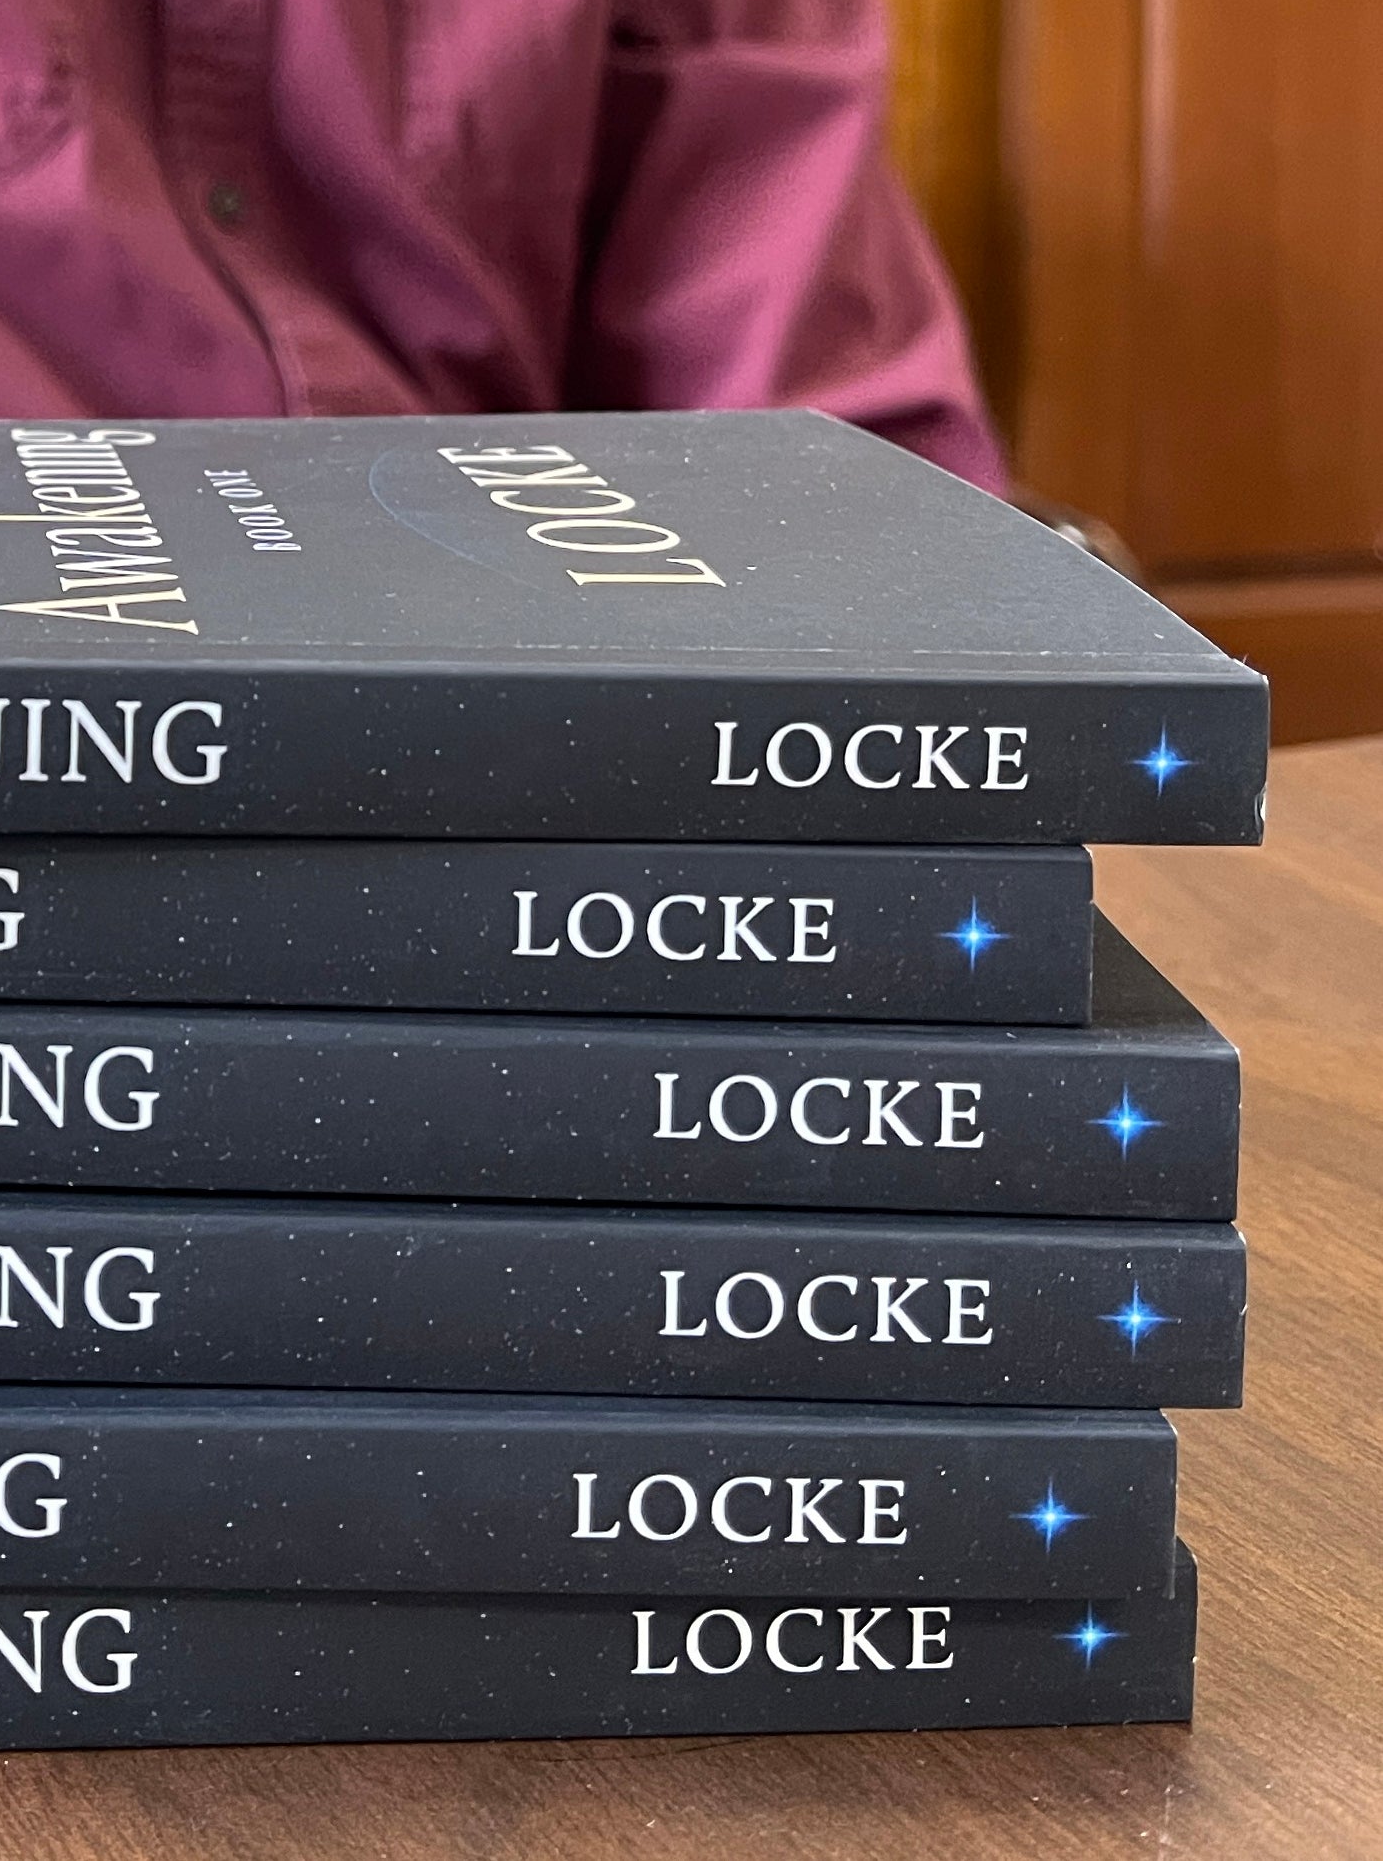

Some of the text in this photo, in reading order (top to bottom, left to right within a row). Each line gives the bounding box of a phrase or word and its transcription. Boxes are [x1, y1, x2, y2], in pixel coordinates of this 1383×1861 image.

[204, 469, 302, 551] BOOK ONE
[437, 445, 727, 588] LOCKE
[709, 720, 1030, 791] LOCKE
[510, 889, 838, 964] LOCKE
[651, 1071, 986, 1150] LOCKE
[656, 1269, 995, 1346] LOCKE
[569, 1472, 909, 1546] LOCKE
[629, 1605, 955, 1676] LOCKE
